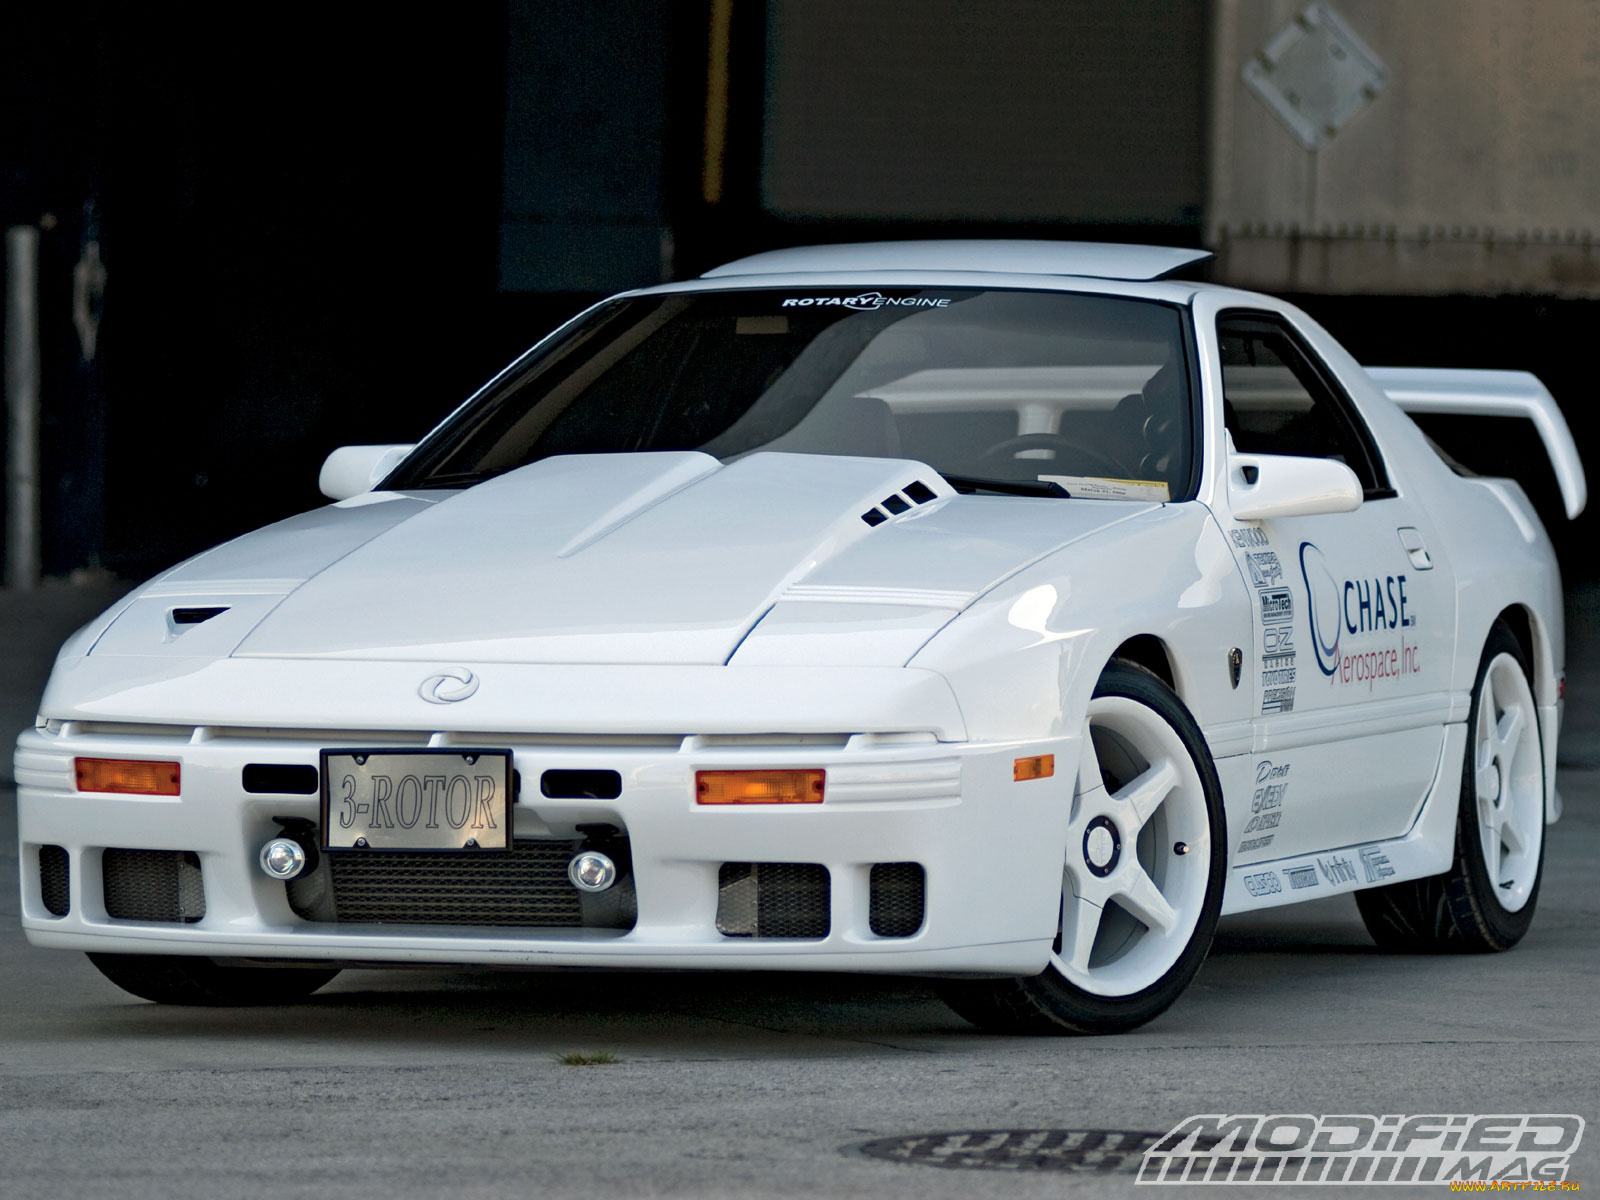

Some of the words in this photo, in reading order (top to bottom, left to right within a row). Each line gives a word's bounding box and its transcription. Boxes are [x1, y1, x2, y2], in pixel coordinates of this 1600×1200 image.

[1228, 527, 1270, 549] KENWOOD
[1344, 575, 1410, 634] CHASE
[1331, 640, 1400, 693] Aerospace,
[1401, 635, 1421, 675] Inc.
[339, 774, 498, 830] 3-ROTOR
